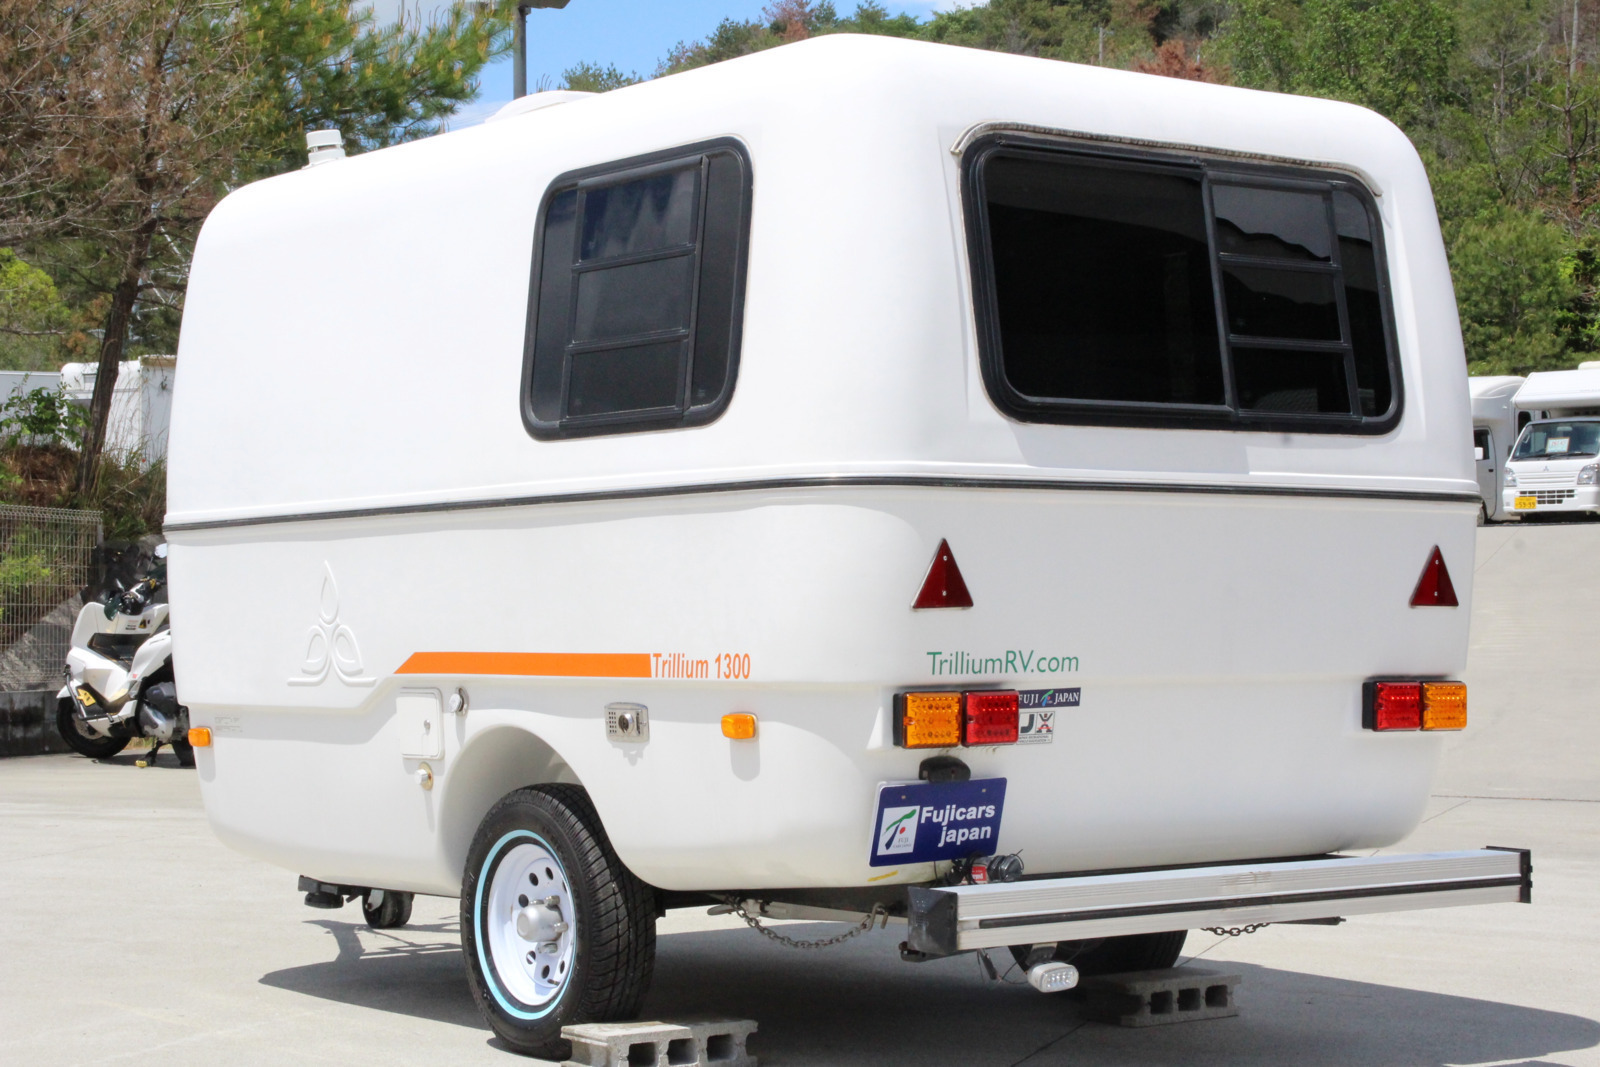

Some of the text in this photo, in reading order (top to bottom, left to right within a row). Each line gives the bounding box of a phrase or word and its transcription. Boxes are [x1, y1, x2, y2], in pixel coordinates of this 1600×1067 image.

[653, 653, 751, 679] Trillium 1300
[926, 650, 1079, 676] TrilliumRV.com
[1019, 692, 1080, 706] FUJI JAPAN
[920, 804, 996, 826] Fujicars
[937, 825, 992, 848] japan
